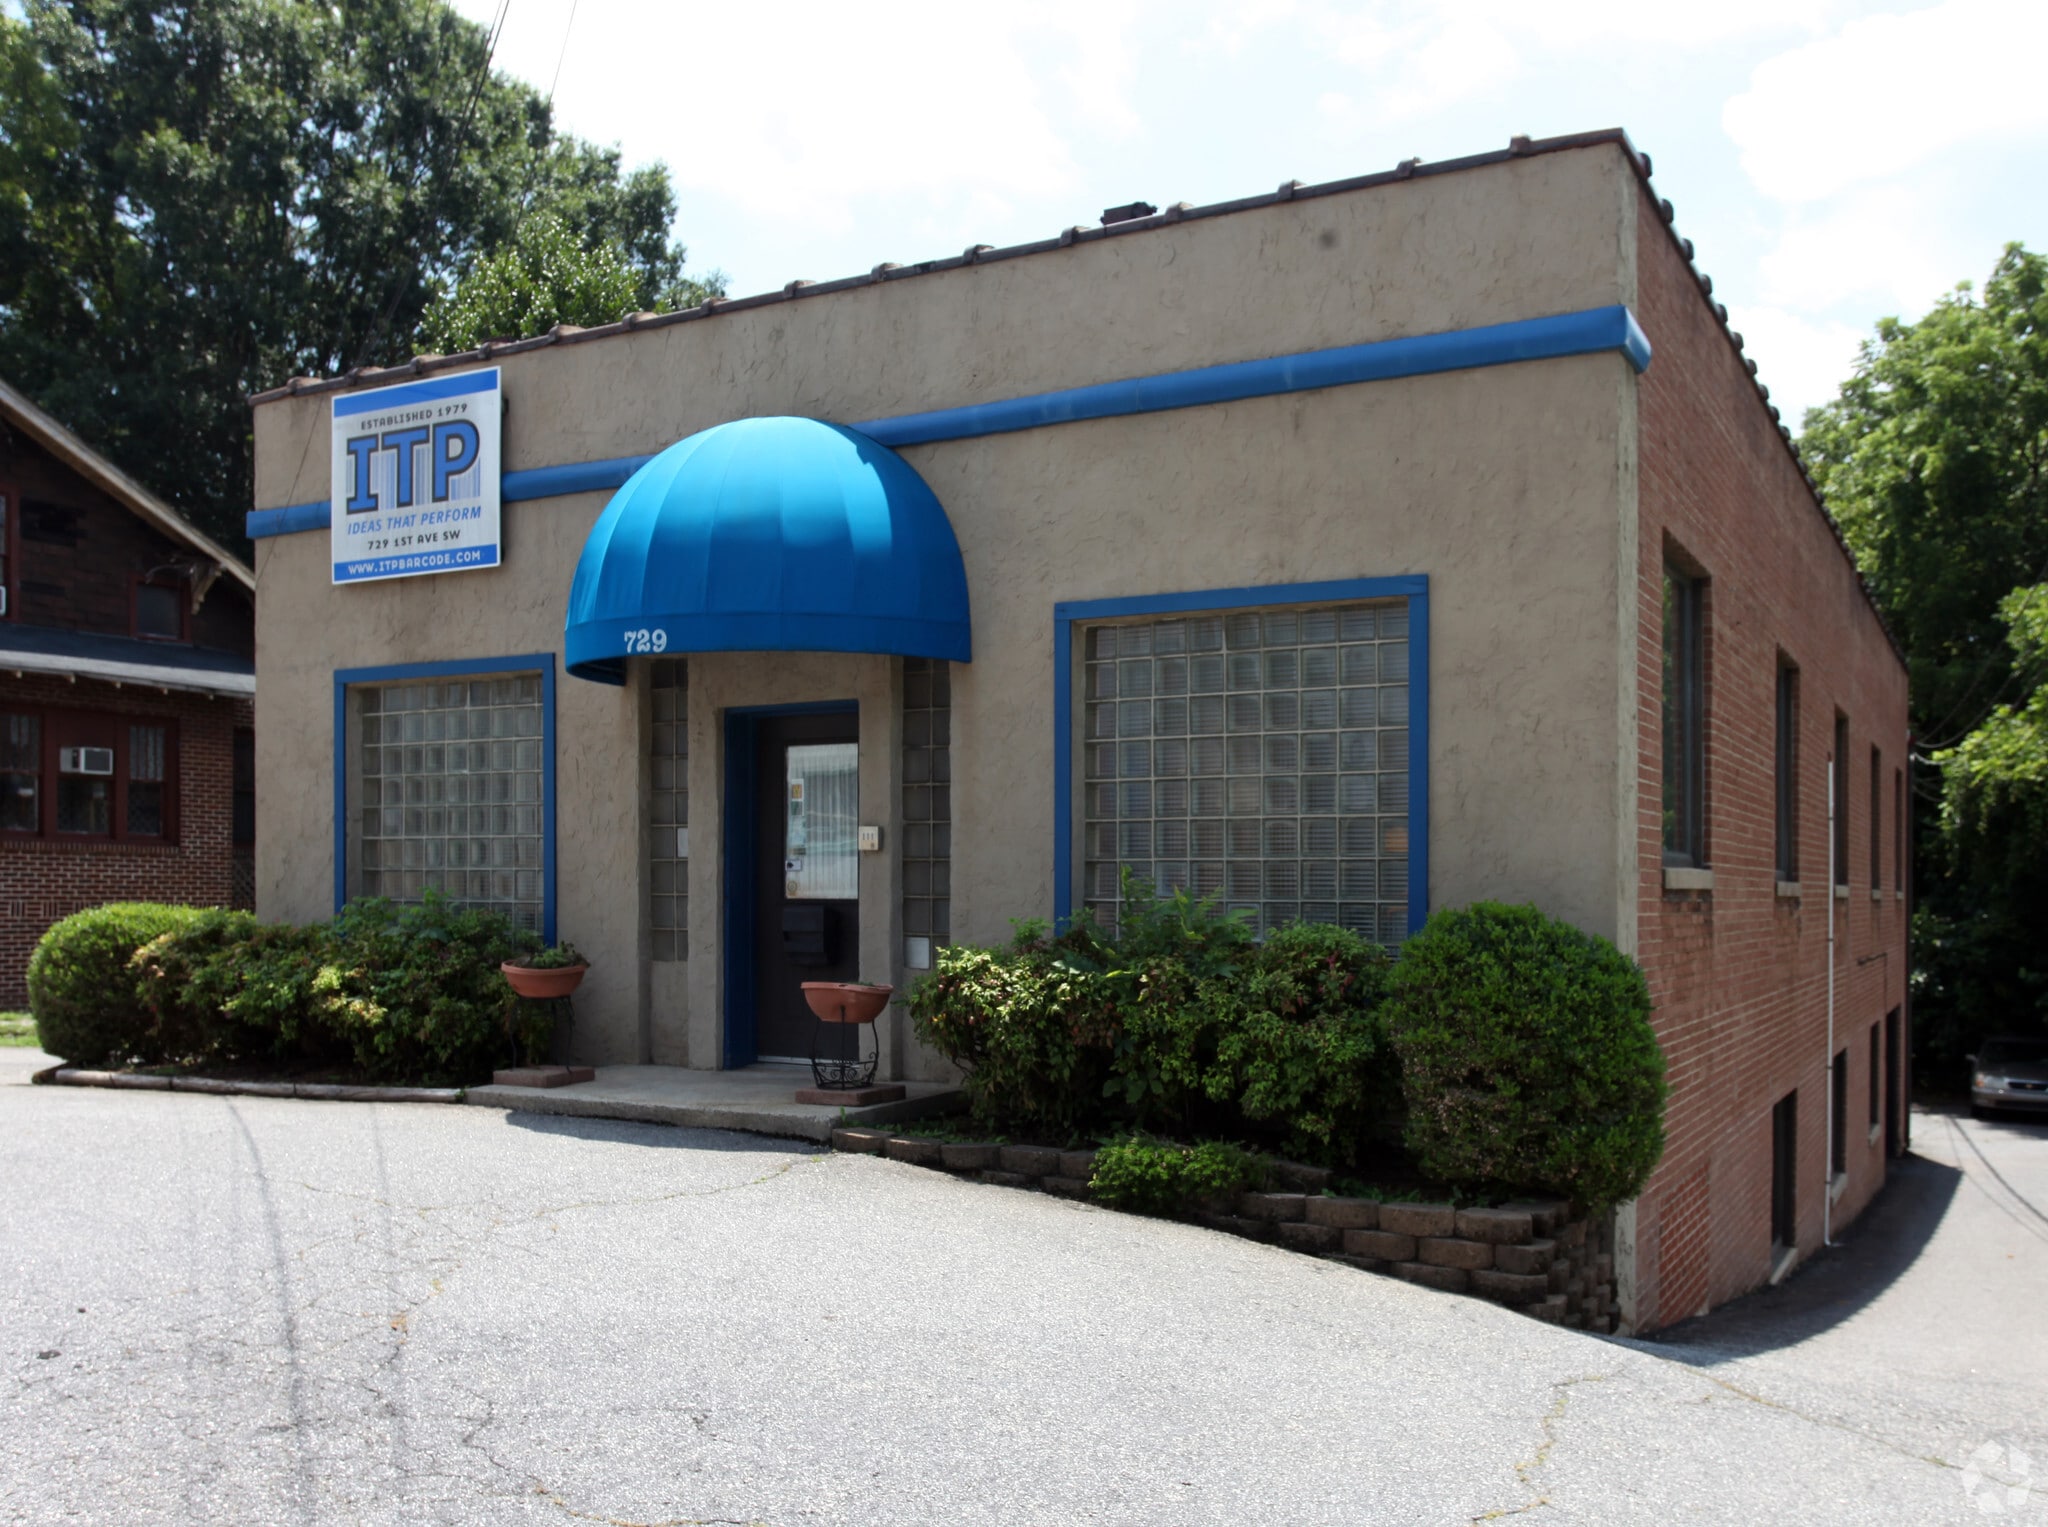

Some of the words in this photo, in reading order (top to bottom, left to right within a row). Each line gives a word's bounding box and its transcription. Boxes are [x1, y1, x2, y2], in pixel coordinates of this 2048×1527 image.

[361, 410, 433, 431] ESTABLISHED
[438, 403, 468, 418] 1979
[346, 418, 480, 515] ITP
[347, 518, 381, 535] IDEAS
[387, 514, 416, 530] THAT
[420, 506, 481, 526] PERFORM
[368, 539, 389, 550] 729
[394, 535, 413, 547] 1ST
[417, 533, 438, 545] AVE
[443, 530, 461, 541] SW
[348, 550, 481, 575] WWW.ITPBARCODE.COM
[624, 628, 667, 653] 729
